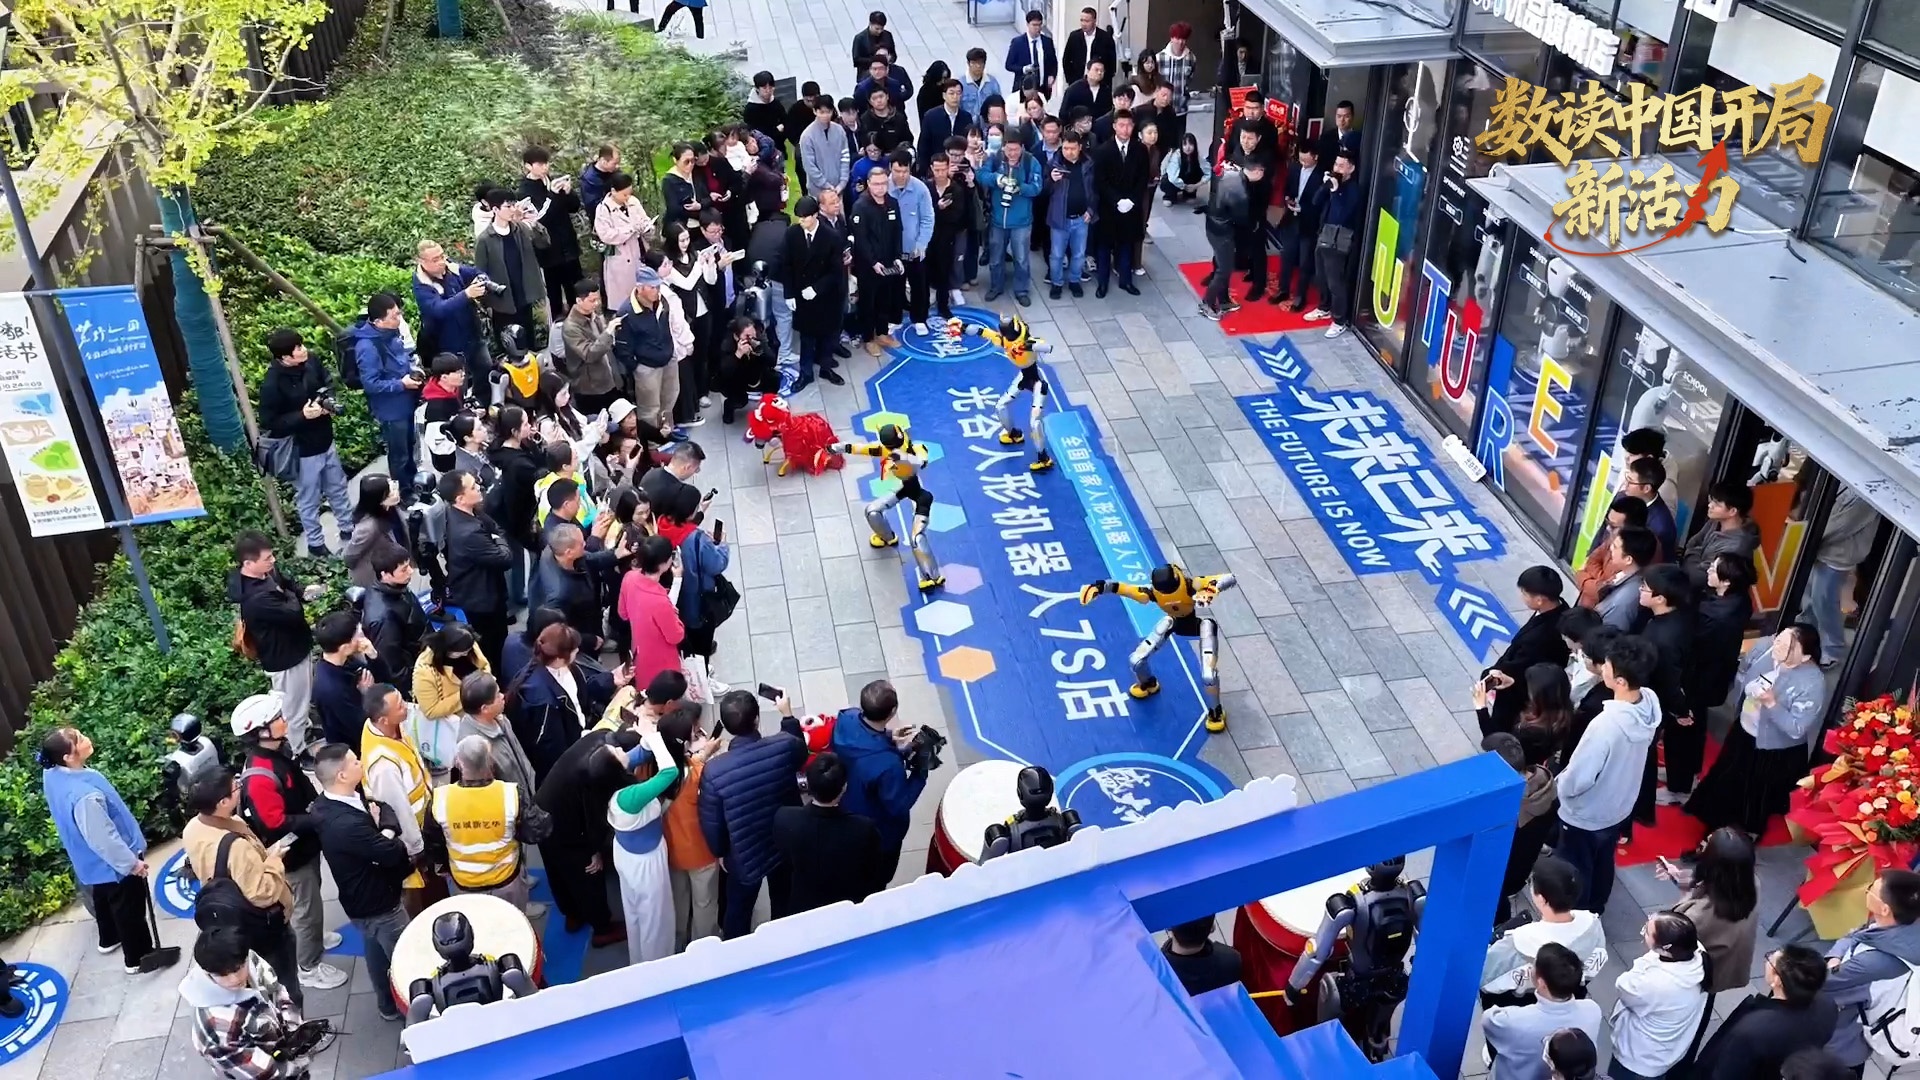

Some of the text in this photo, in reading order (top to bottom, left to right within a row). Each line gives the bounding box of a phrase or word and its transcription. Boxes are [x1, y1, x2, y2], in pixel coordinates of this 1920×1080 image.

[1567, 277, 1592, 303] SOLUTION
[1682, 371, 1708, 397] SCHOOL
[947, 385, 1130, 721] 光谷人形机器人7S店
[1060, 436, 1149, 584] 全国首家人形机器人7S
[1250, 398, 1391, 567] THE FUTURE IS NOW
[1289, 385, 1492, 578] 未来已来
